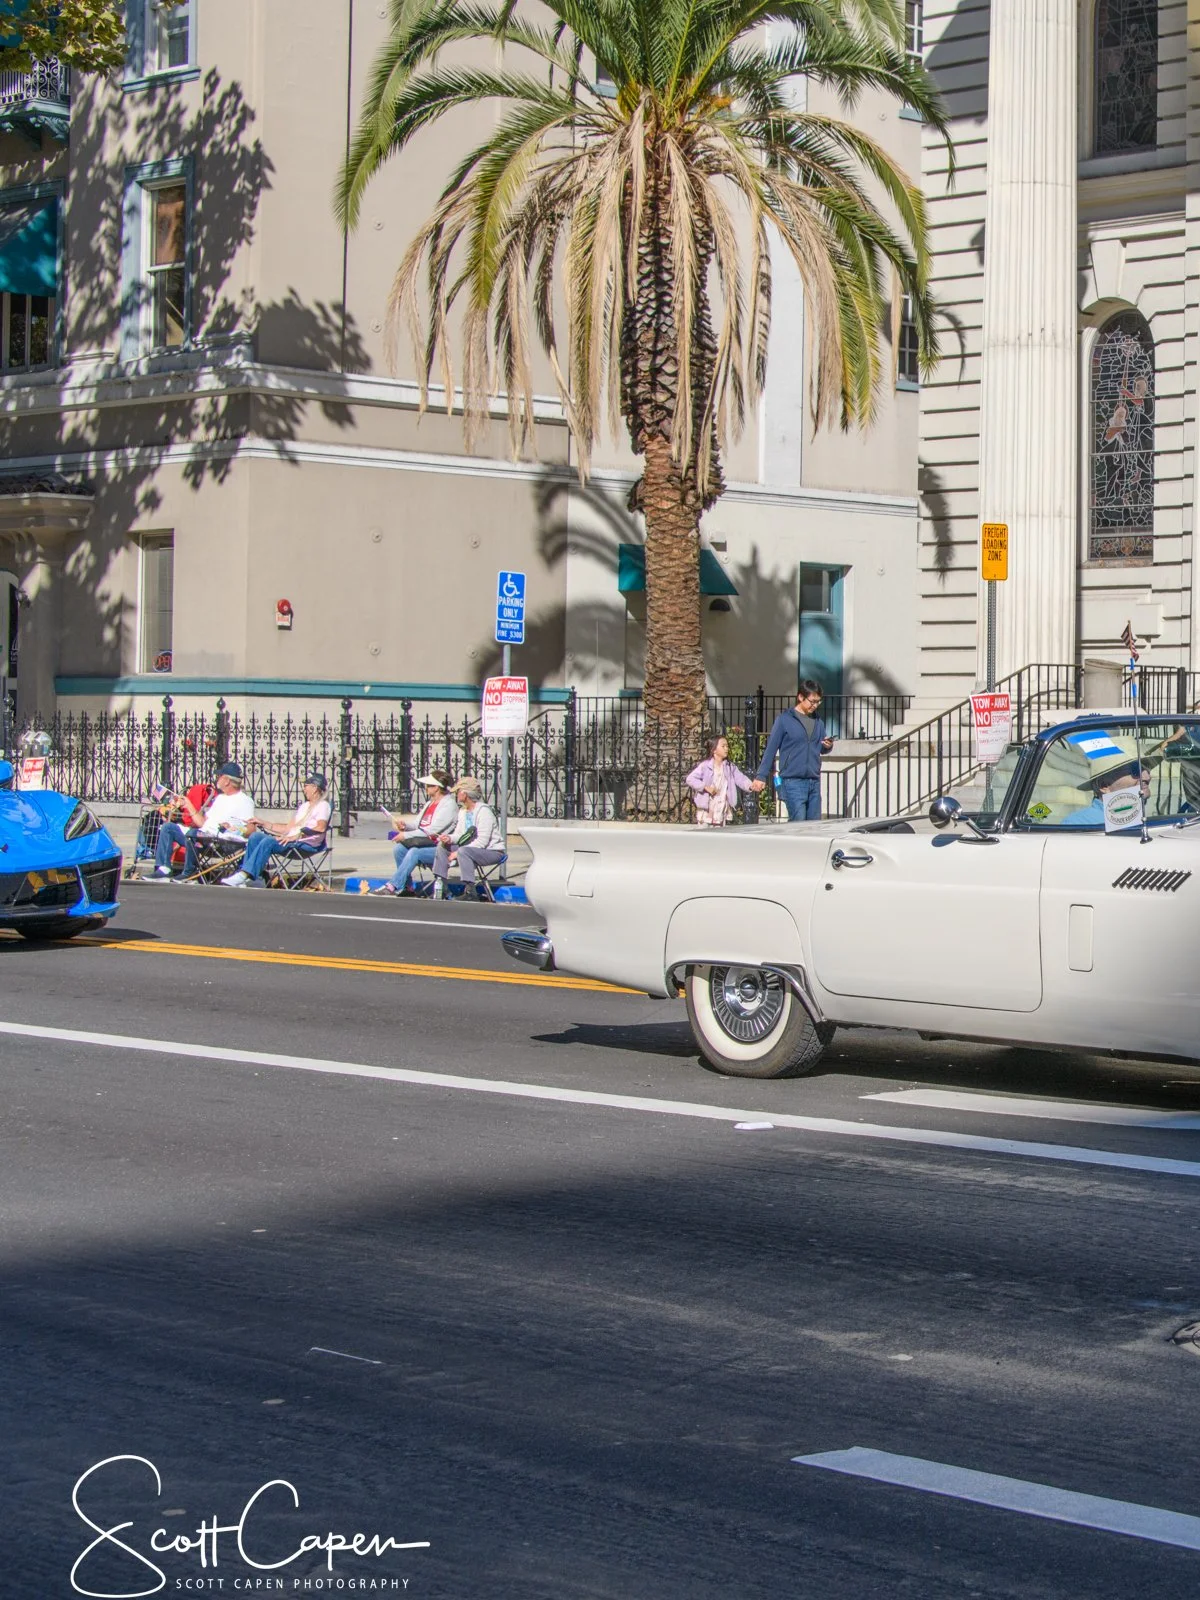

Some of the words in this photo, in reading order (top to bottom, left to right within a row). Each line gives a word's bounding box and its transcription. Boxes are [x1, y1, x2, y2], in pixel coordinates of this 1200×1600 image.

[984, 527, 1006, 538] FREIGHT
[983, 539, 1007, 550] LOADING
[988, 550, 1002, 561] ZONE
[498, 596, 523, 607] PARKING
[503, 607, 518, 618] ONLY
[487, 680, 502, 691] TOW
[506, 680, 524, 691] AWAY
[486, 692, 501, 705] NO
[974, 698, 990, 708] TOW
[994, 697, 1008, 708] AWAY
[976, 711, 991, 725] NO
